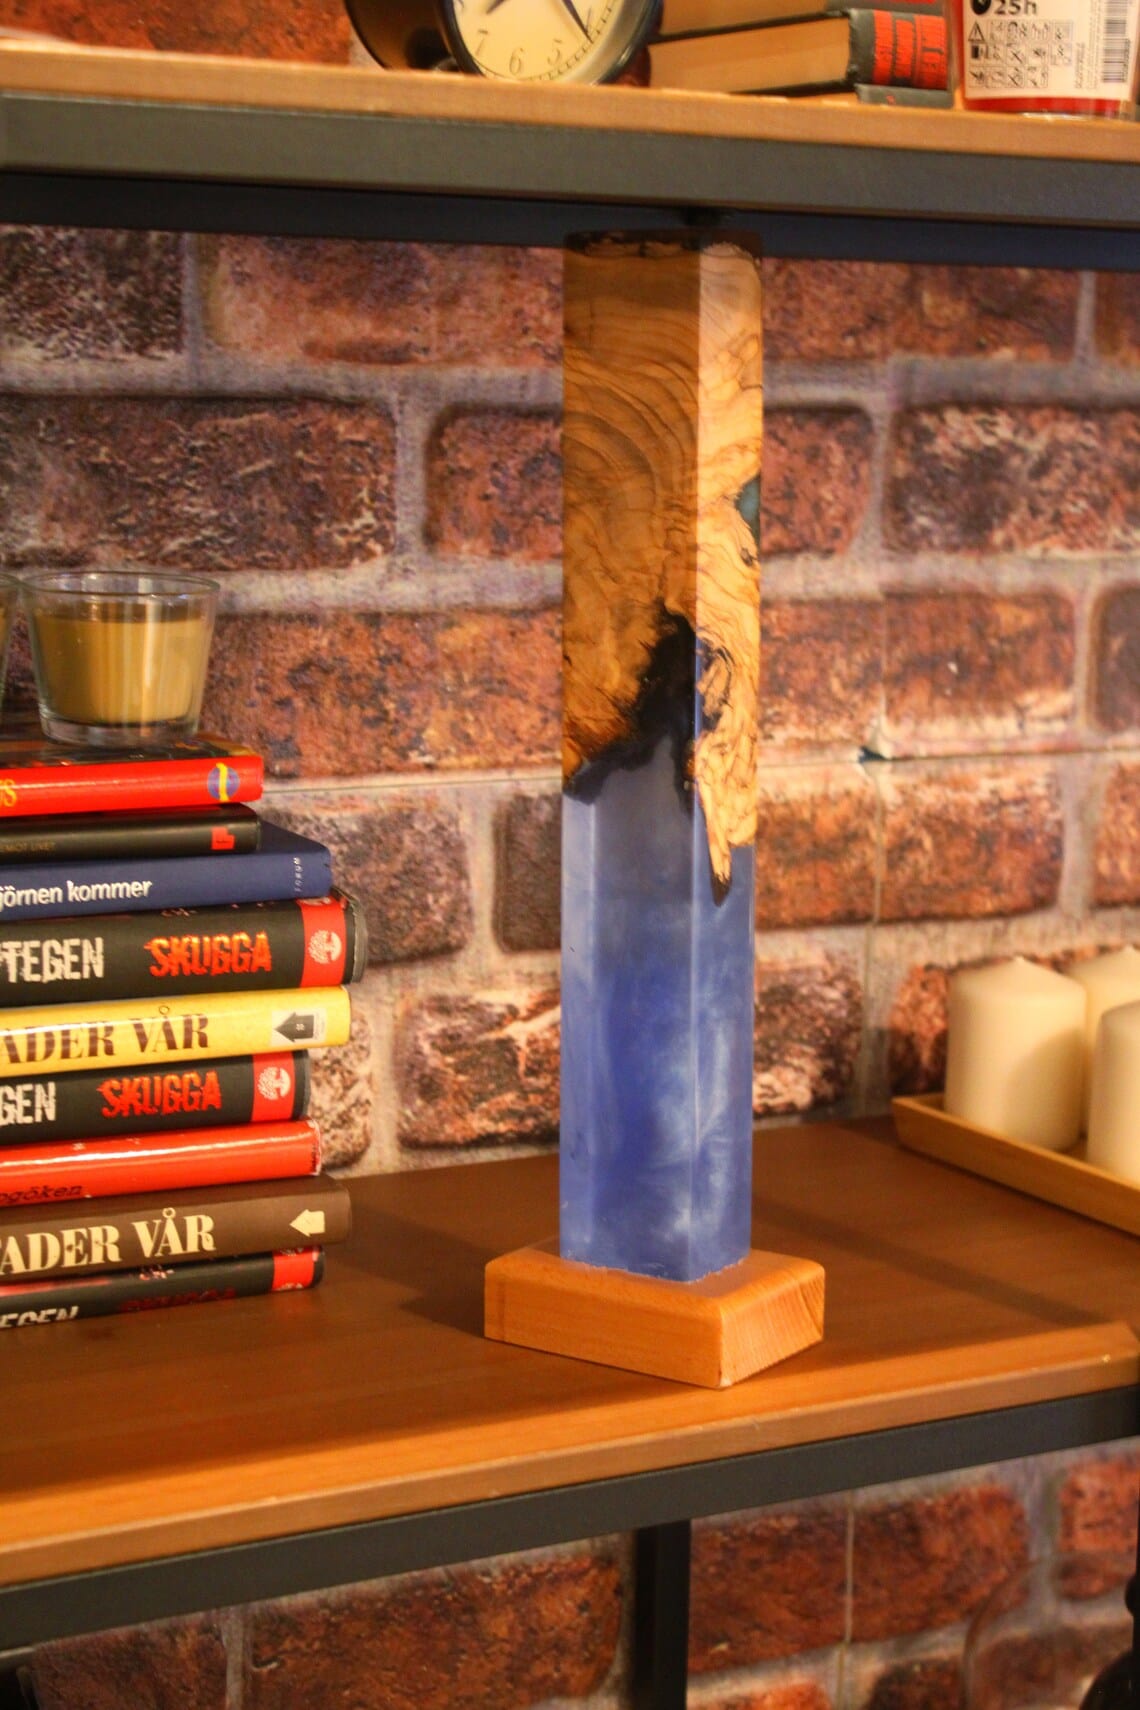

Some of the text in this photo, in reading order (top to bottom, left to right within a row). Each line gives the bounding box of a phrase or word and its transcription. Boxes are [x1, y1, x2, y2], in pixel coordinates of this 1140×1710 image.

[509, 47, 525, 76] 6
[66, 880, 153, 902] kommer
[0, 930, 272, 984] TEGEN SKUGGA
[128, 1005, 210, 1053] VÅR
[97, 1069, 222, 1118] SKUGGA
[0, 1207, 216, 1276] ADER VÅR
